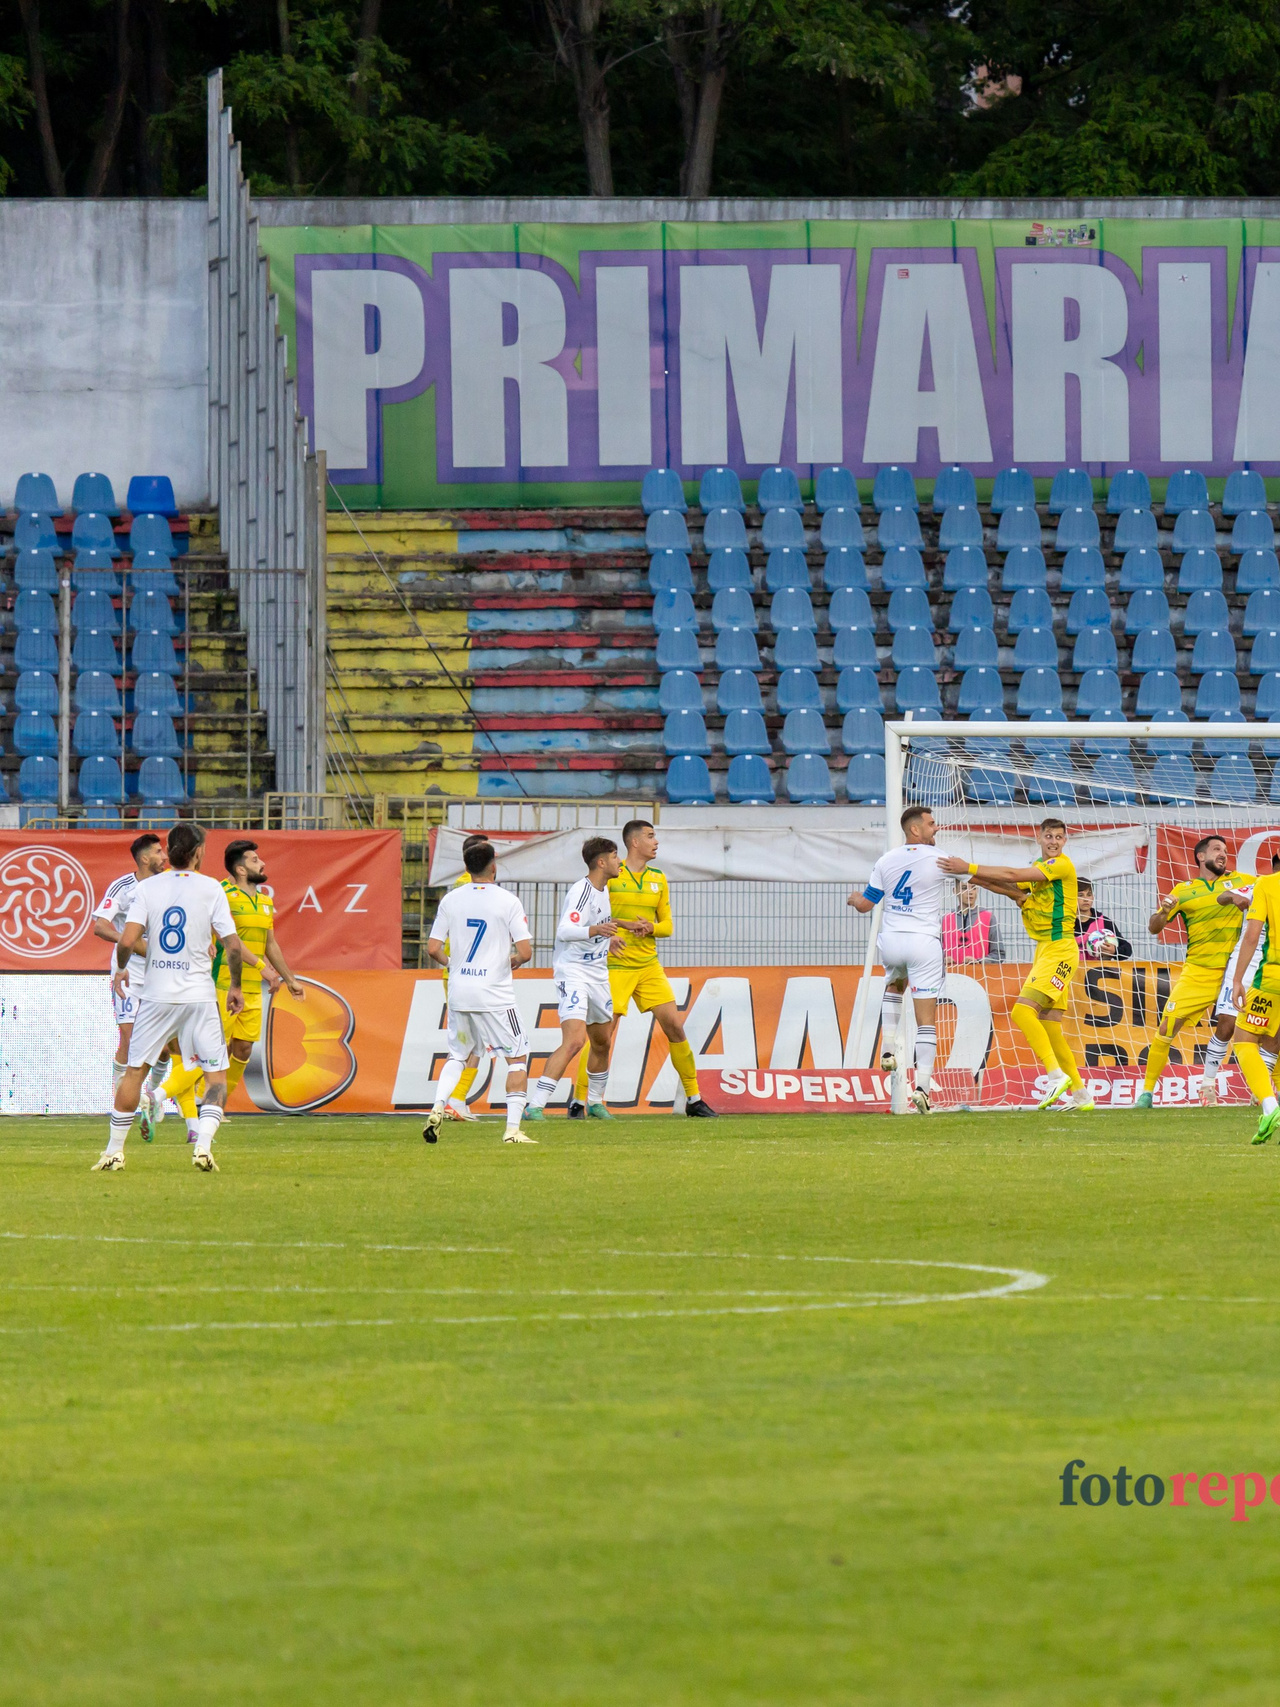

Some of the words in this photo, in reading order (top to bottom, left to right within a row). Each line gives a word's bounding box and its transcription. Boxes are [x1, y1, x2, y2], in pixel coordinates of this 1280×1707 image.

[892, 869, 914, 906] 4
[158, 905, 187, 955] 8
[466, 918, 488, 963] 7
[151, 959, 191, 971] FLORESCU
[460, 967, 488, 977] MAILAT
[1058, 960, 1072, 974] APA
[1056, 966, 1068, 979] DIN
[1050, 975, 1065, 991] NOY
[121, 996, 133, 1013] 16
[570, 990, 580, 1005] 6
[1253, 995, 1273, 1008] APA
[1250, 1003, 1268, 1015] DIN
[1246, 1014, 1269, 1027] NOY
